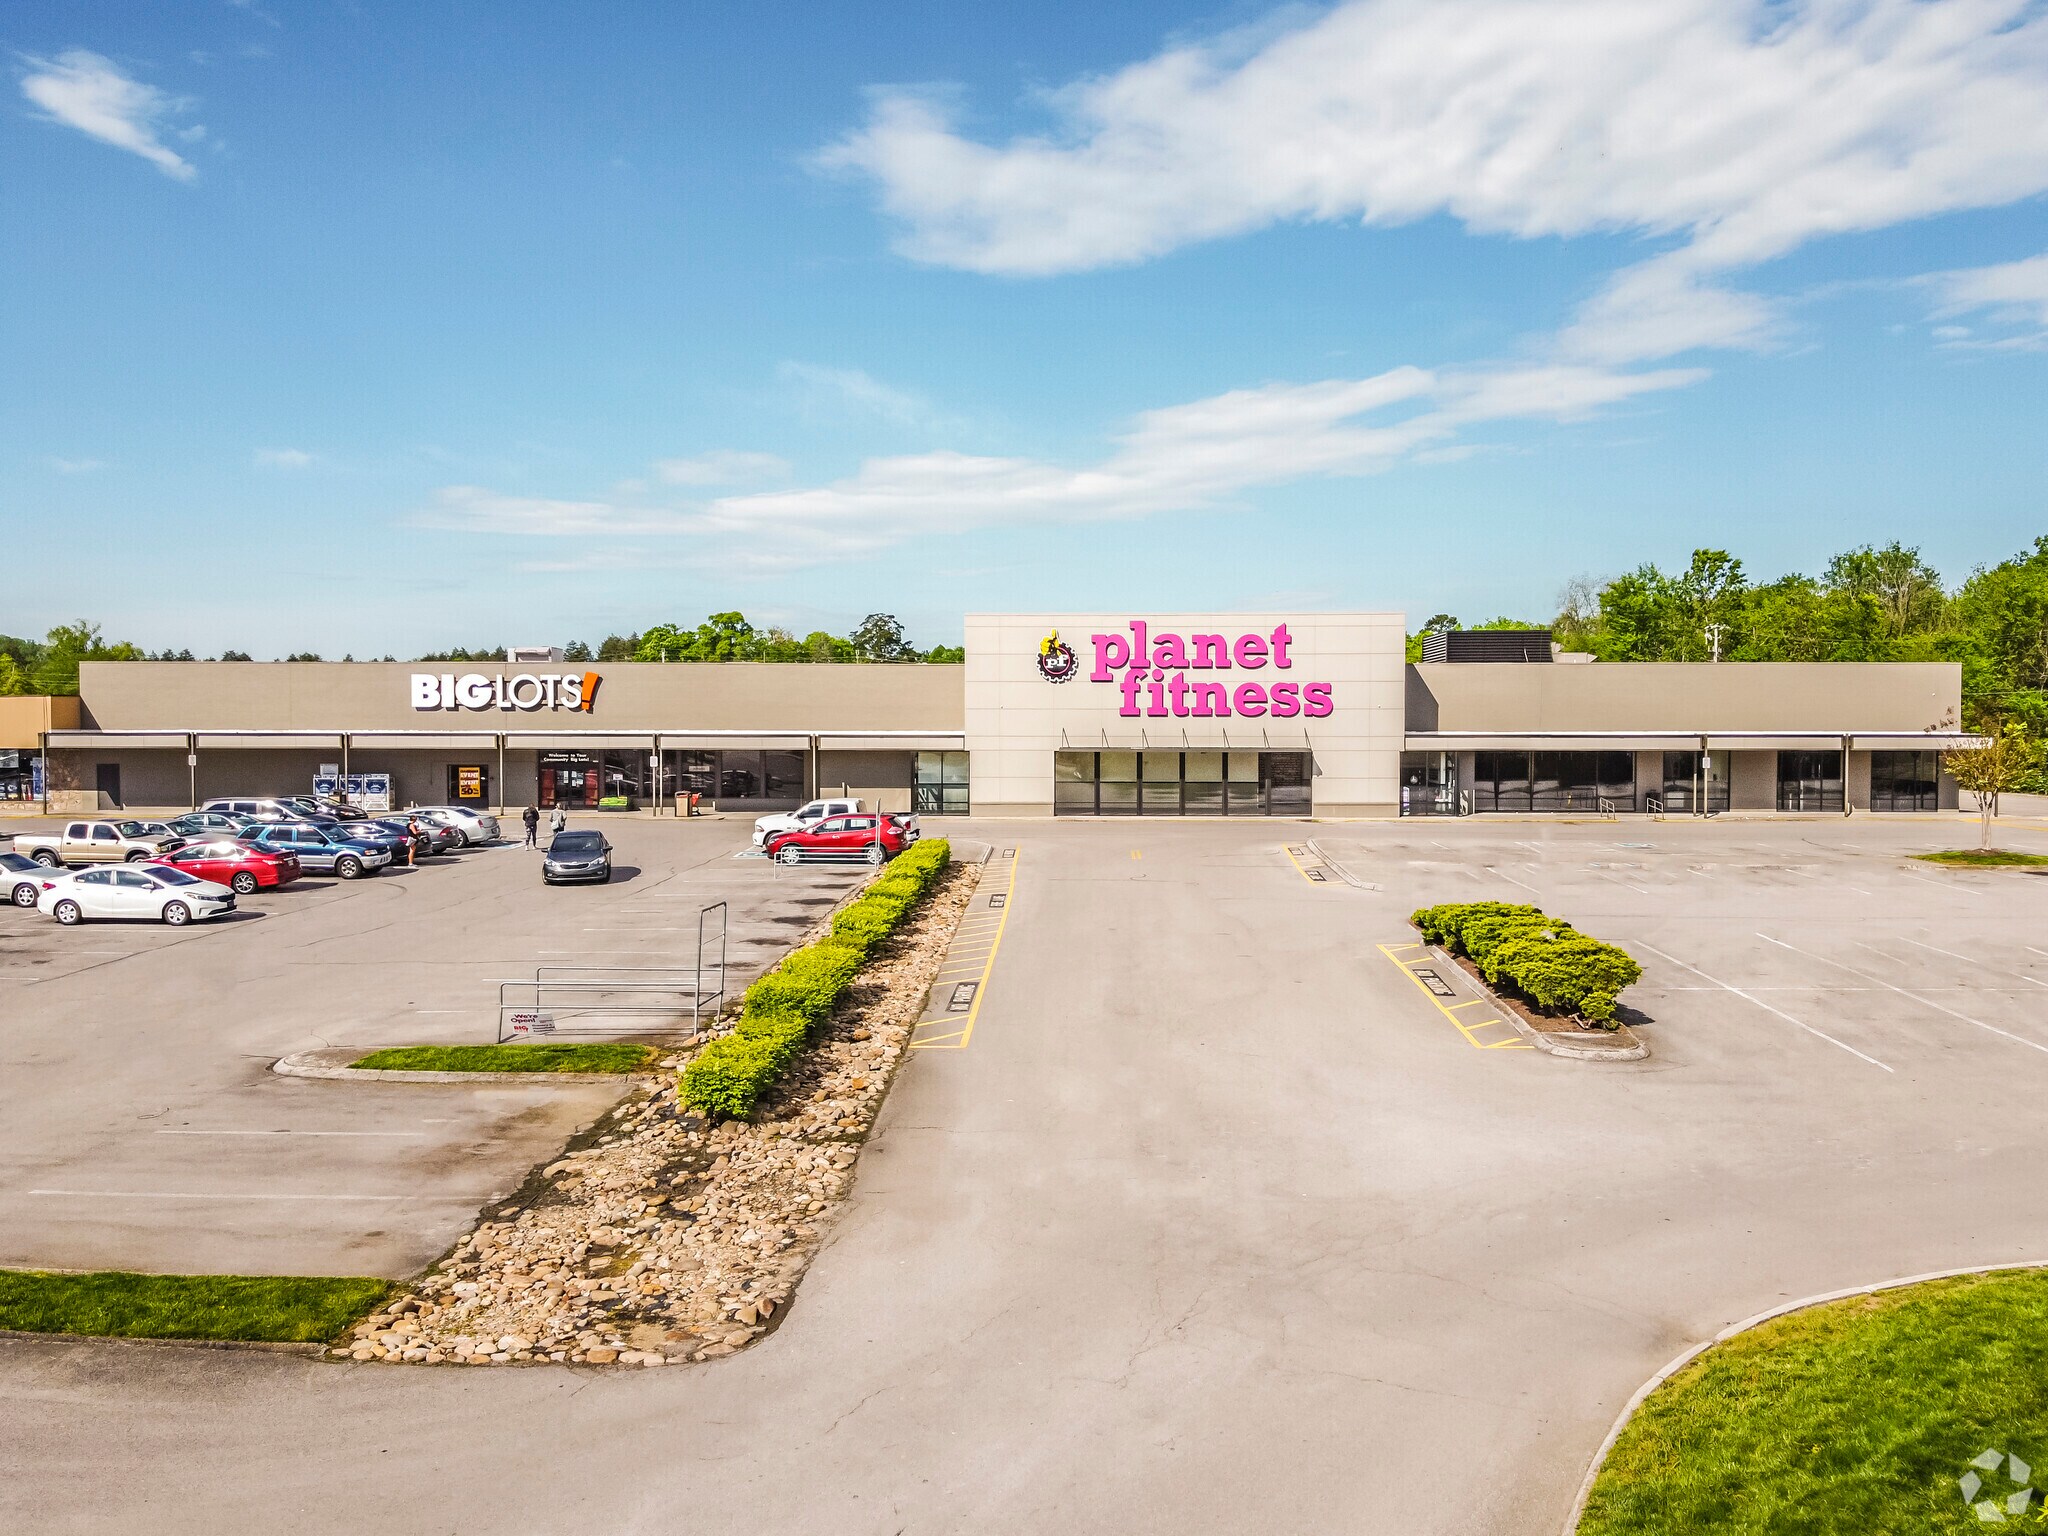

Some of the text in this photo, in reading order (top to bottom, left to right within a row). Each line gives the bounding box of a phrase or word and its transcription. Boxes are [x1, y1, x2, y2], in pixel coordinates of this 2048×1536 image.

[1046, 654, 1069, 669] pf
[1090, 620, 1293, 683] planet
[411, 672, 600, 710] BIG LOTS!
[1119, 668, 1335, 718] fitness
